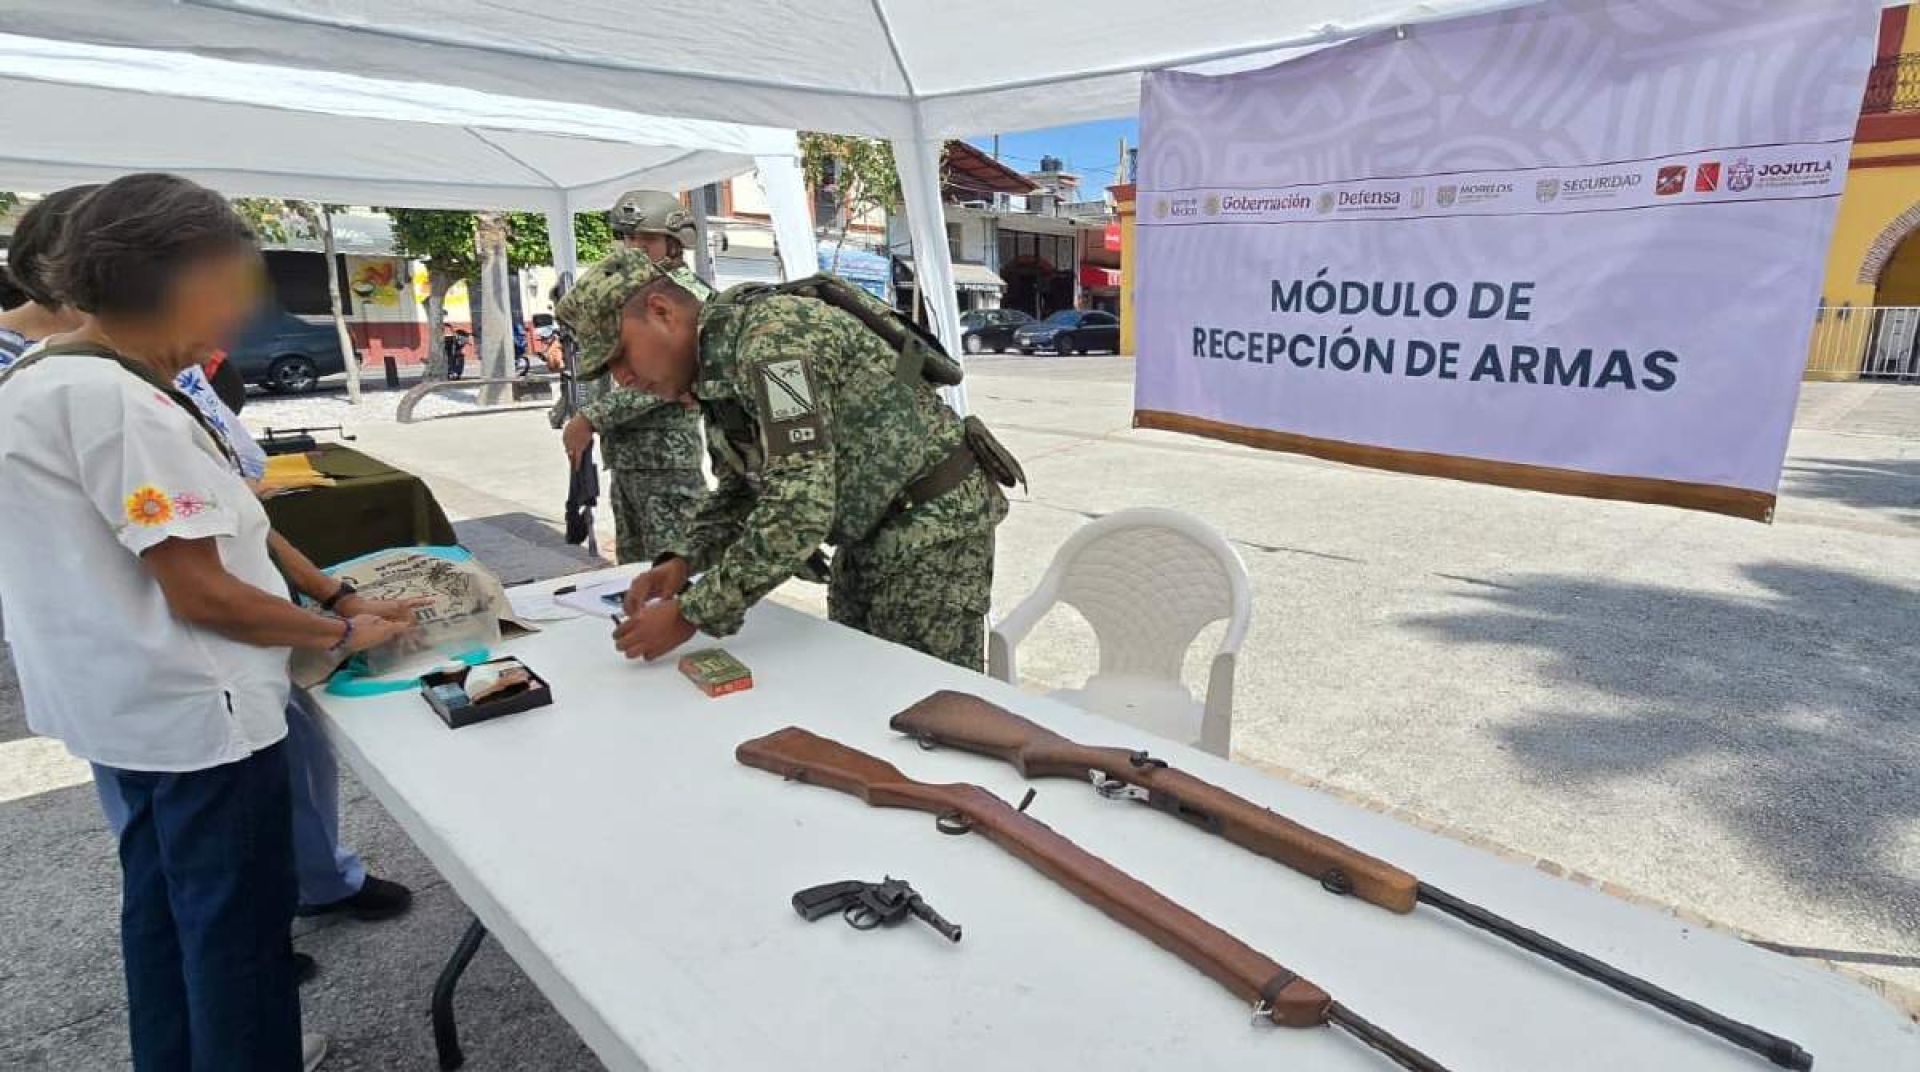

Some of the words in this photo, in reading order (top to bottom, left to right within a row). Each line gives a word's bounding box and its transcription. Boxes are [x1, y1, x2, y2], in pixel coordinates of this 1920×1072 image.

[1758, 160, 1832, 177] JOJUTLA
[1563, 174, 1642, 192] SEGURIDAD
[1222, 193, 1311, 211] Gobernación
[1338, 190, 1401, 206] Defensa
[1271, 267, 1457, 318] MÓDULO
[1468, 281, 1535, 321] DE
[1192, 325, 1395, 374] RECEPCIÓN
[1405, 340, 1460, 379] DE
[1470, 343, 1679, 392] ARMAS
